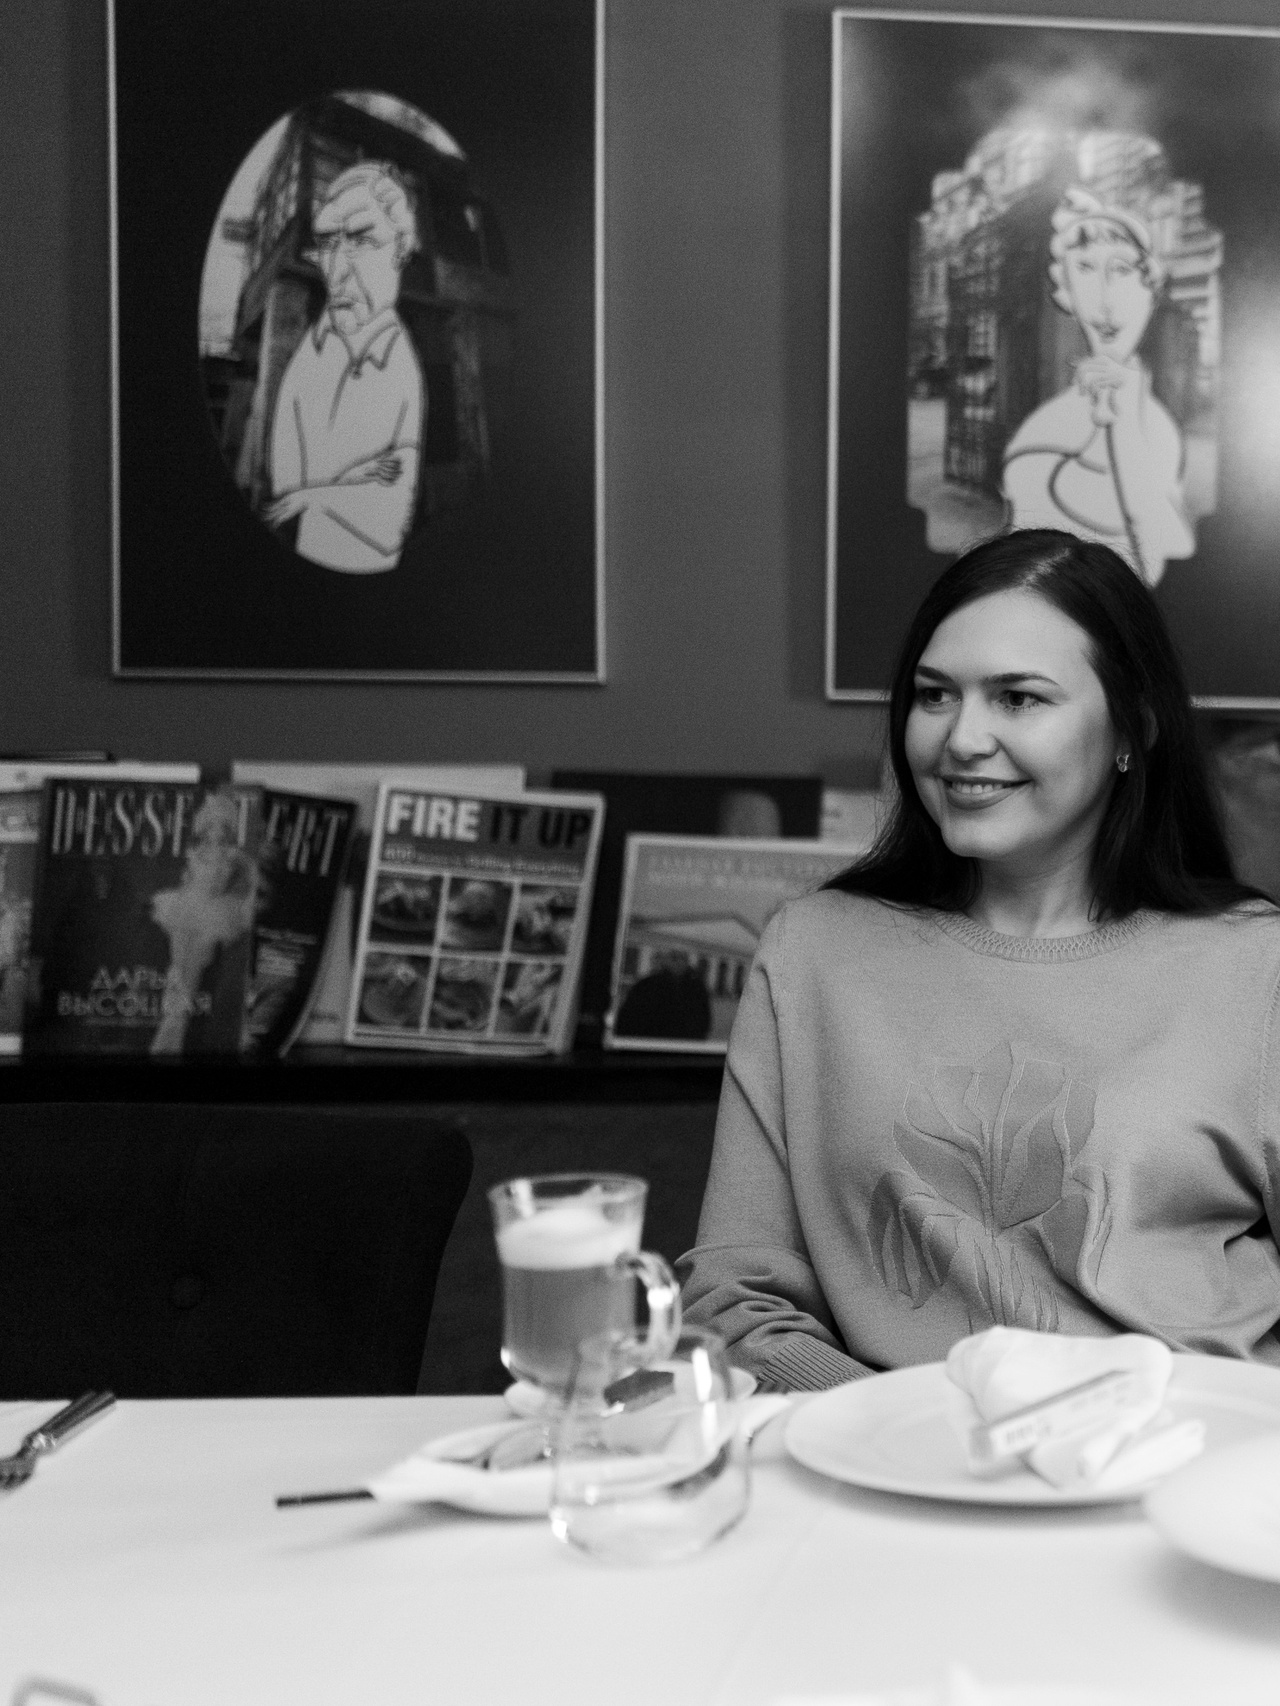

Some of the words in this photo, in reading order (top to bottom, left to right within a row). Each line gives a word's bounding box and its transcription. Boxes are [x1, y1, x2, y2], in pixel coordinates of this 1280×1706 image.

[51, 787, 256, 857] DESSET
[387, 794, 481, 842] FIRE
[489, 805, 529, 843] IT
[538, 809, 592, 848] UP
